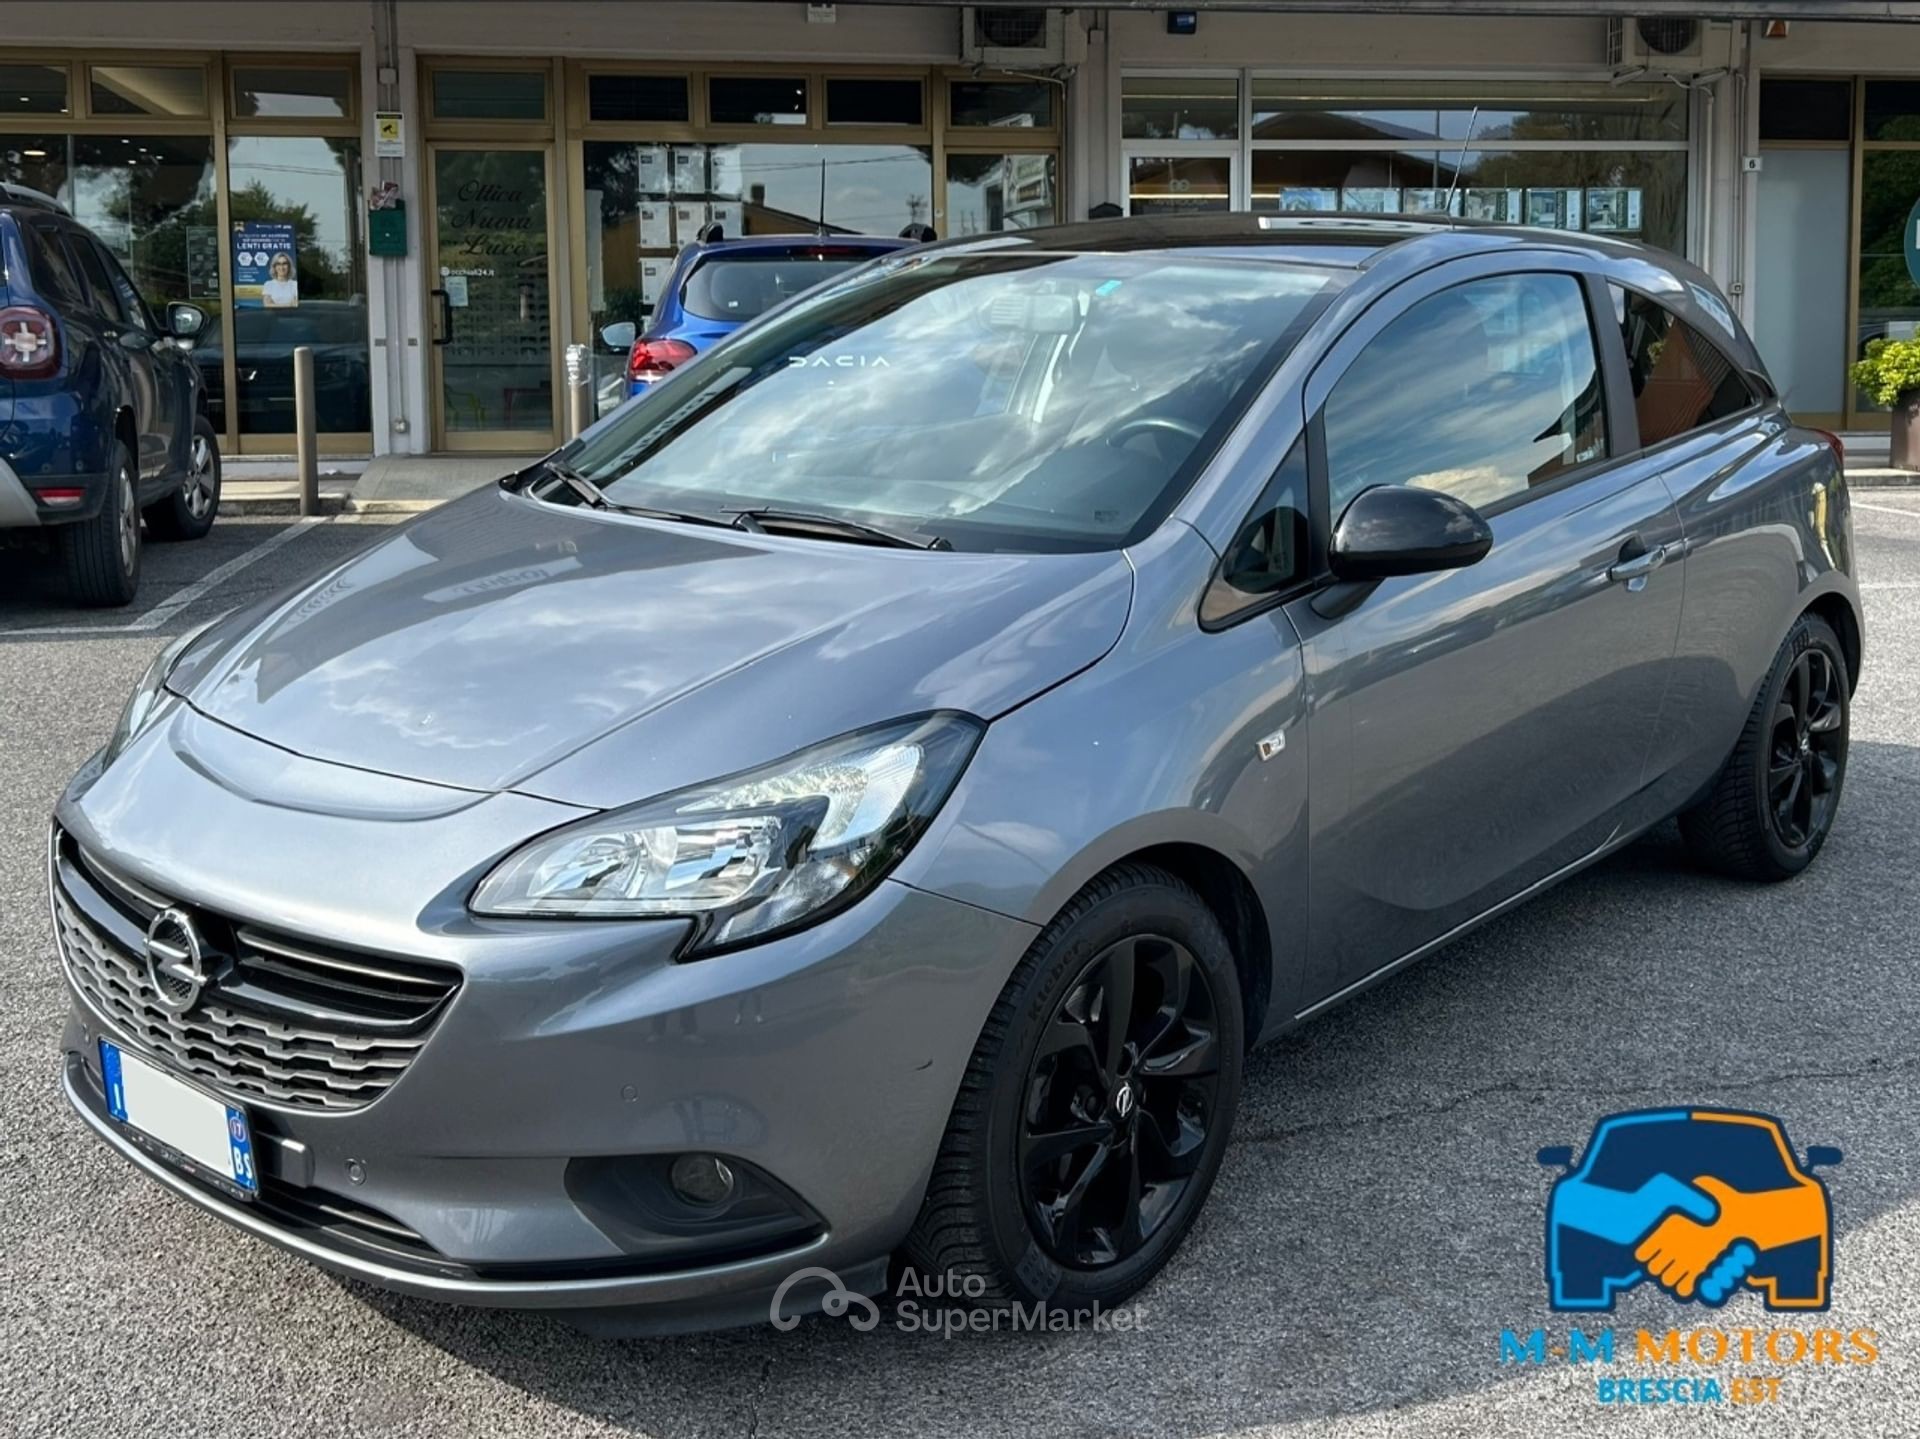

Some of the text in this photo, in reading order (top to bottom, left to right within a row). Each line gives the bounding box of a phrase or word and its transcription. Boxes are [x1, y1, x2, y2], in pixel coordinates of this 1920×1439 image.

[1749, 159, 1756, 168] 6
[457, 179, 523, 202] Ottica
[451, 206, 531, 229] Nuova
[459, 233, 527, 255] Luce
[788, 355, 890, 368] DACIA
[233, 1147, 252, 1179] BS
